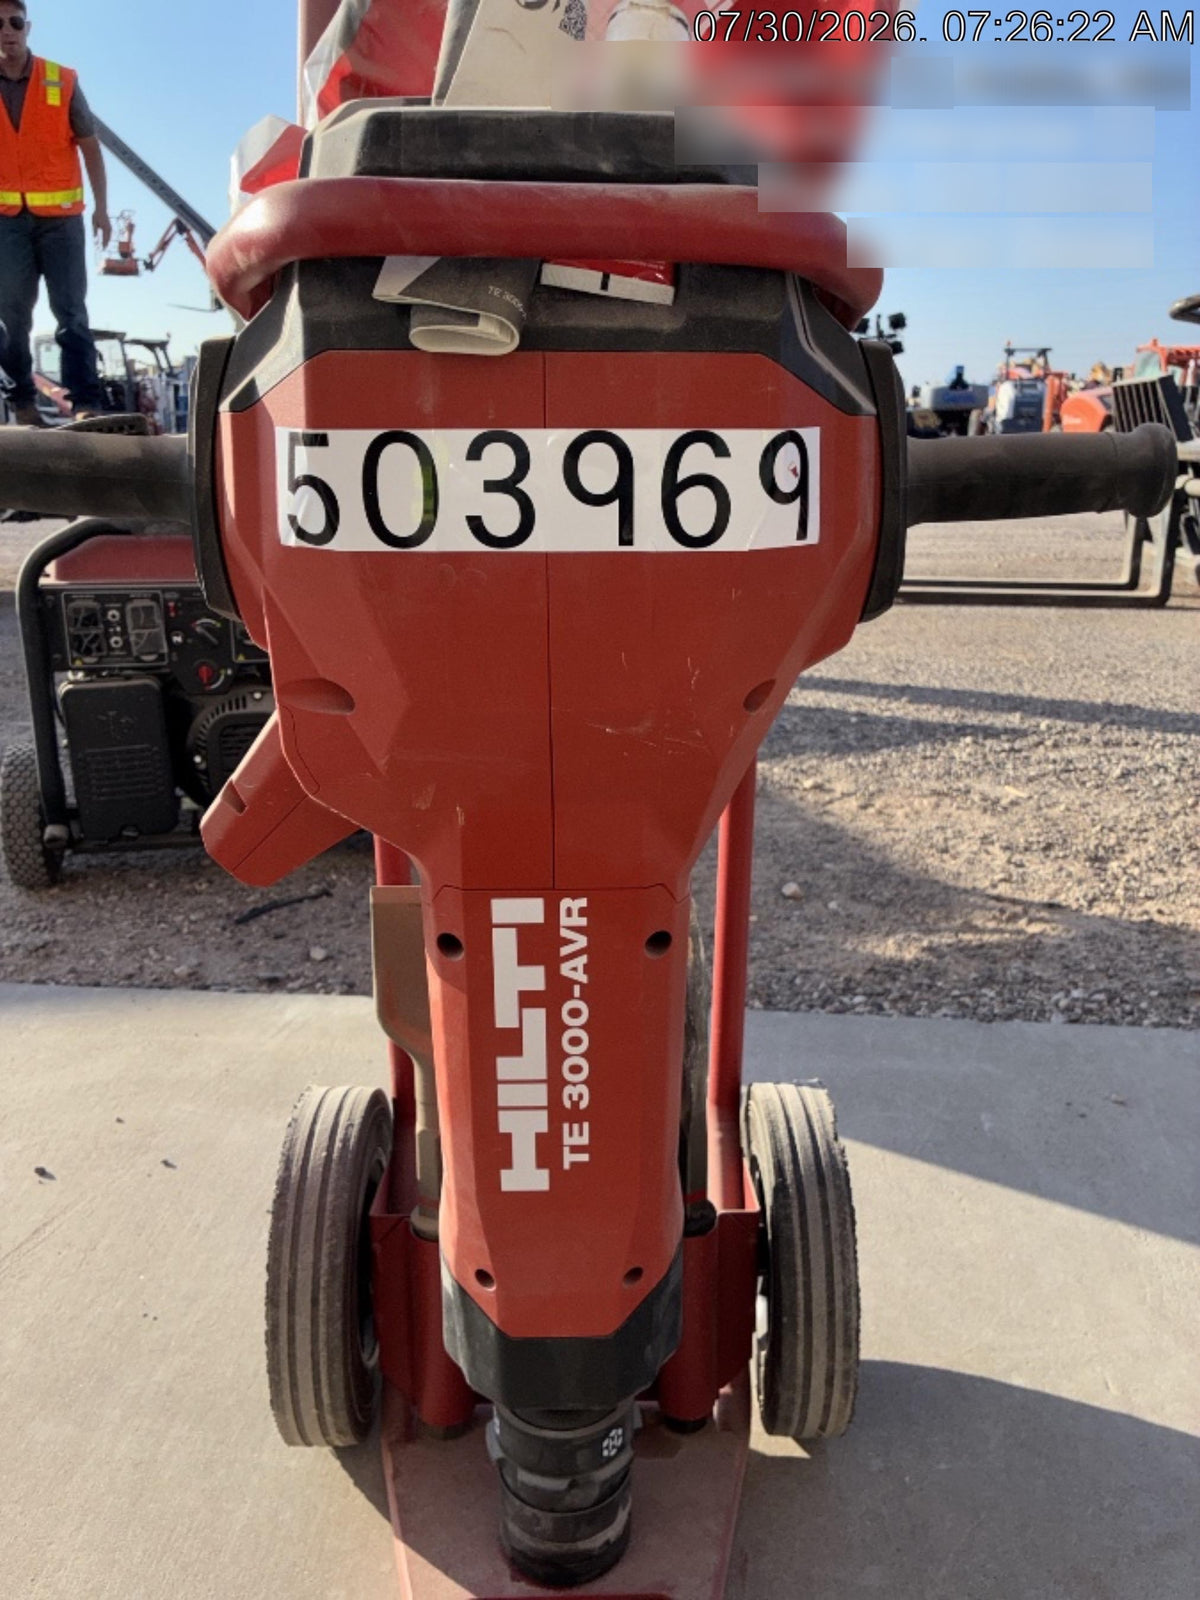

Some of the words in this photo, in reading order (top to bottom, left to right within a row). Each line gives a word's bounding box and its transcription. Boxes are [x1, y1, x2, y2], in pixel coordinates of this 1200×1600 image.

[287, 429, 810, 549] 503969
[490, 897, 550, 1192] HILTI
[559, 897, 590, 1110] 3000-AVR
[563, 1121, 590, 1170] TE
